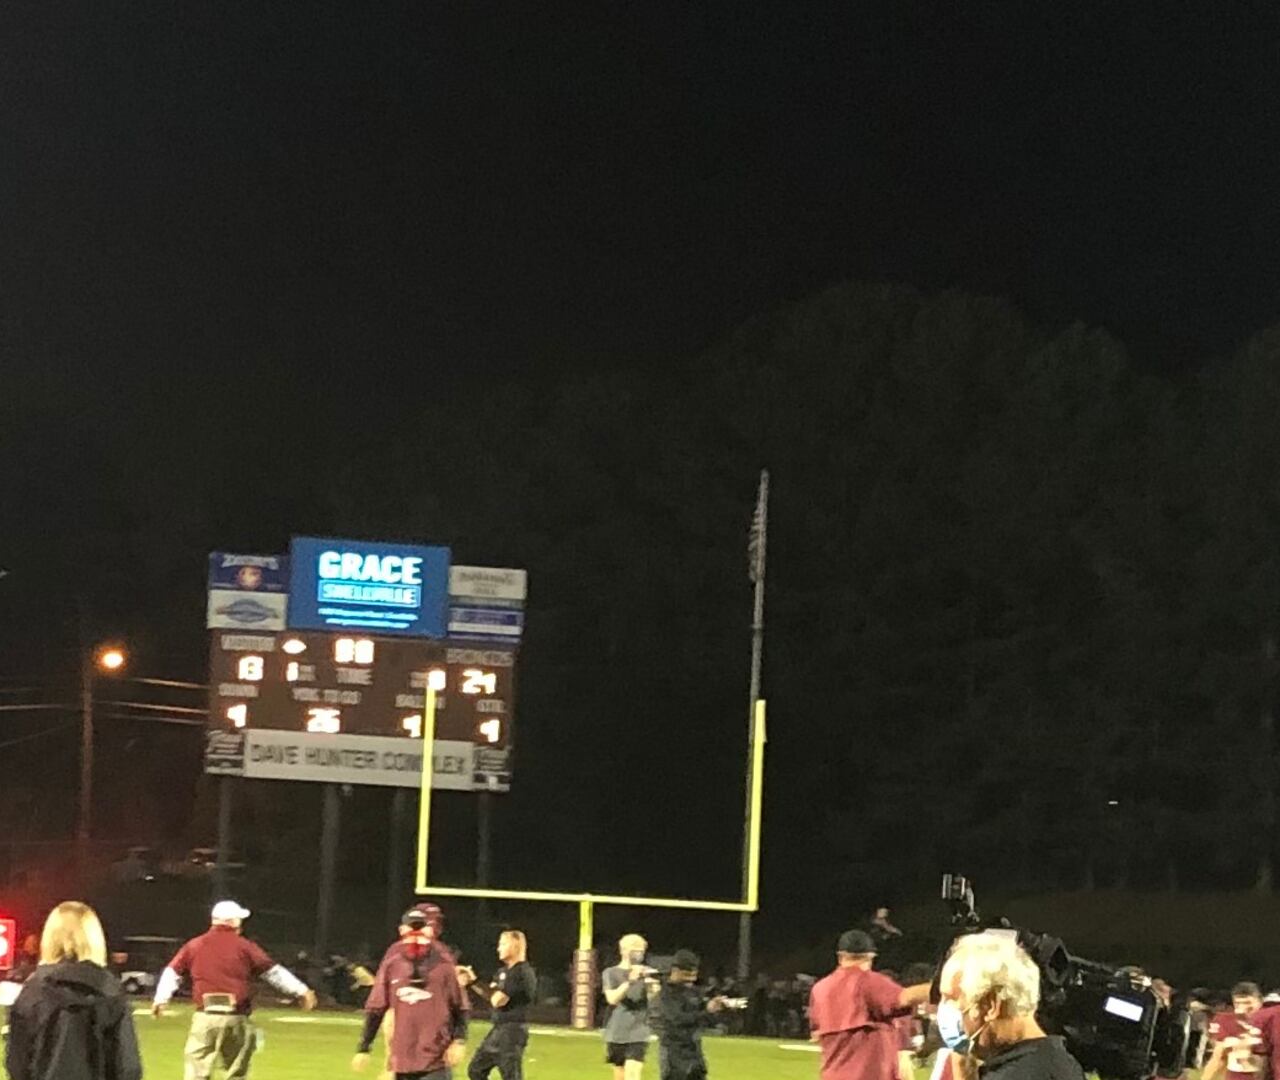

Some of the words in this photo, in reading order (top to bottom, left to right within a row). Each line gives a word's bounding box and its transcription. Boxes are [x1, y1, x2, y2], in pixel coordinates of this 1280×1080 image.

[319, 551, 423, 585] GRACE
[462, 668, 496, 694] 24
[251, 743, 298, 765] DAVE
[305, 747, 376, 770] HUNTER
[383, 751, 465, 776] COMLEX
